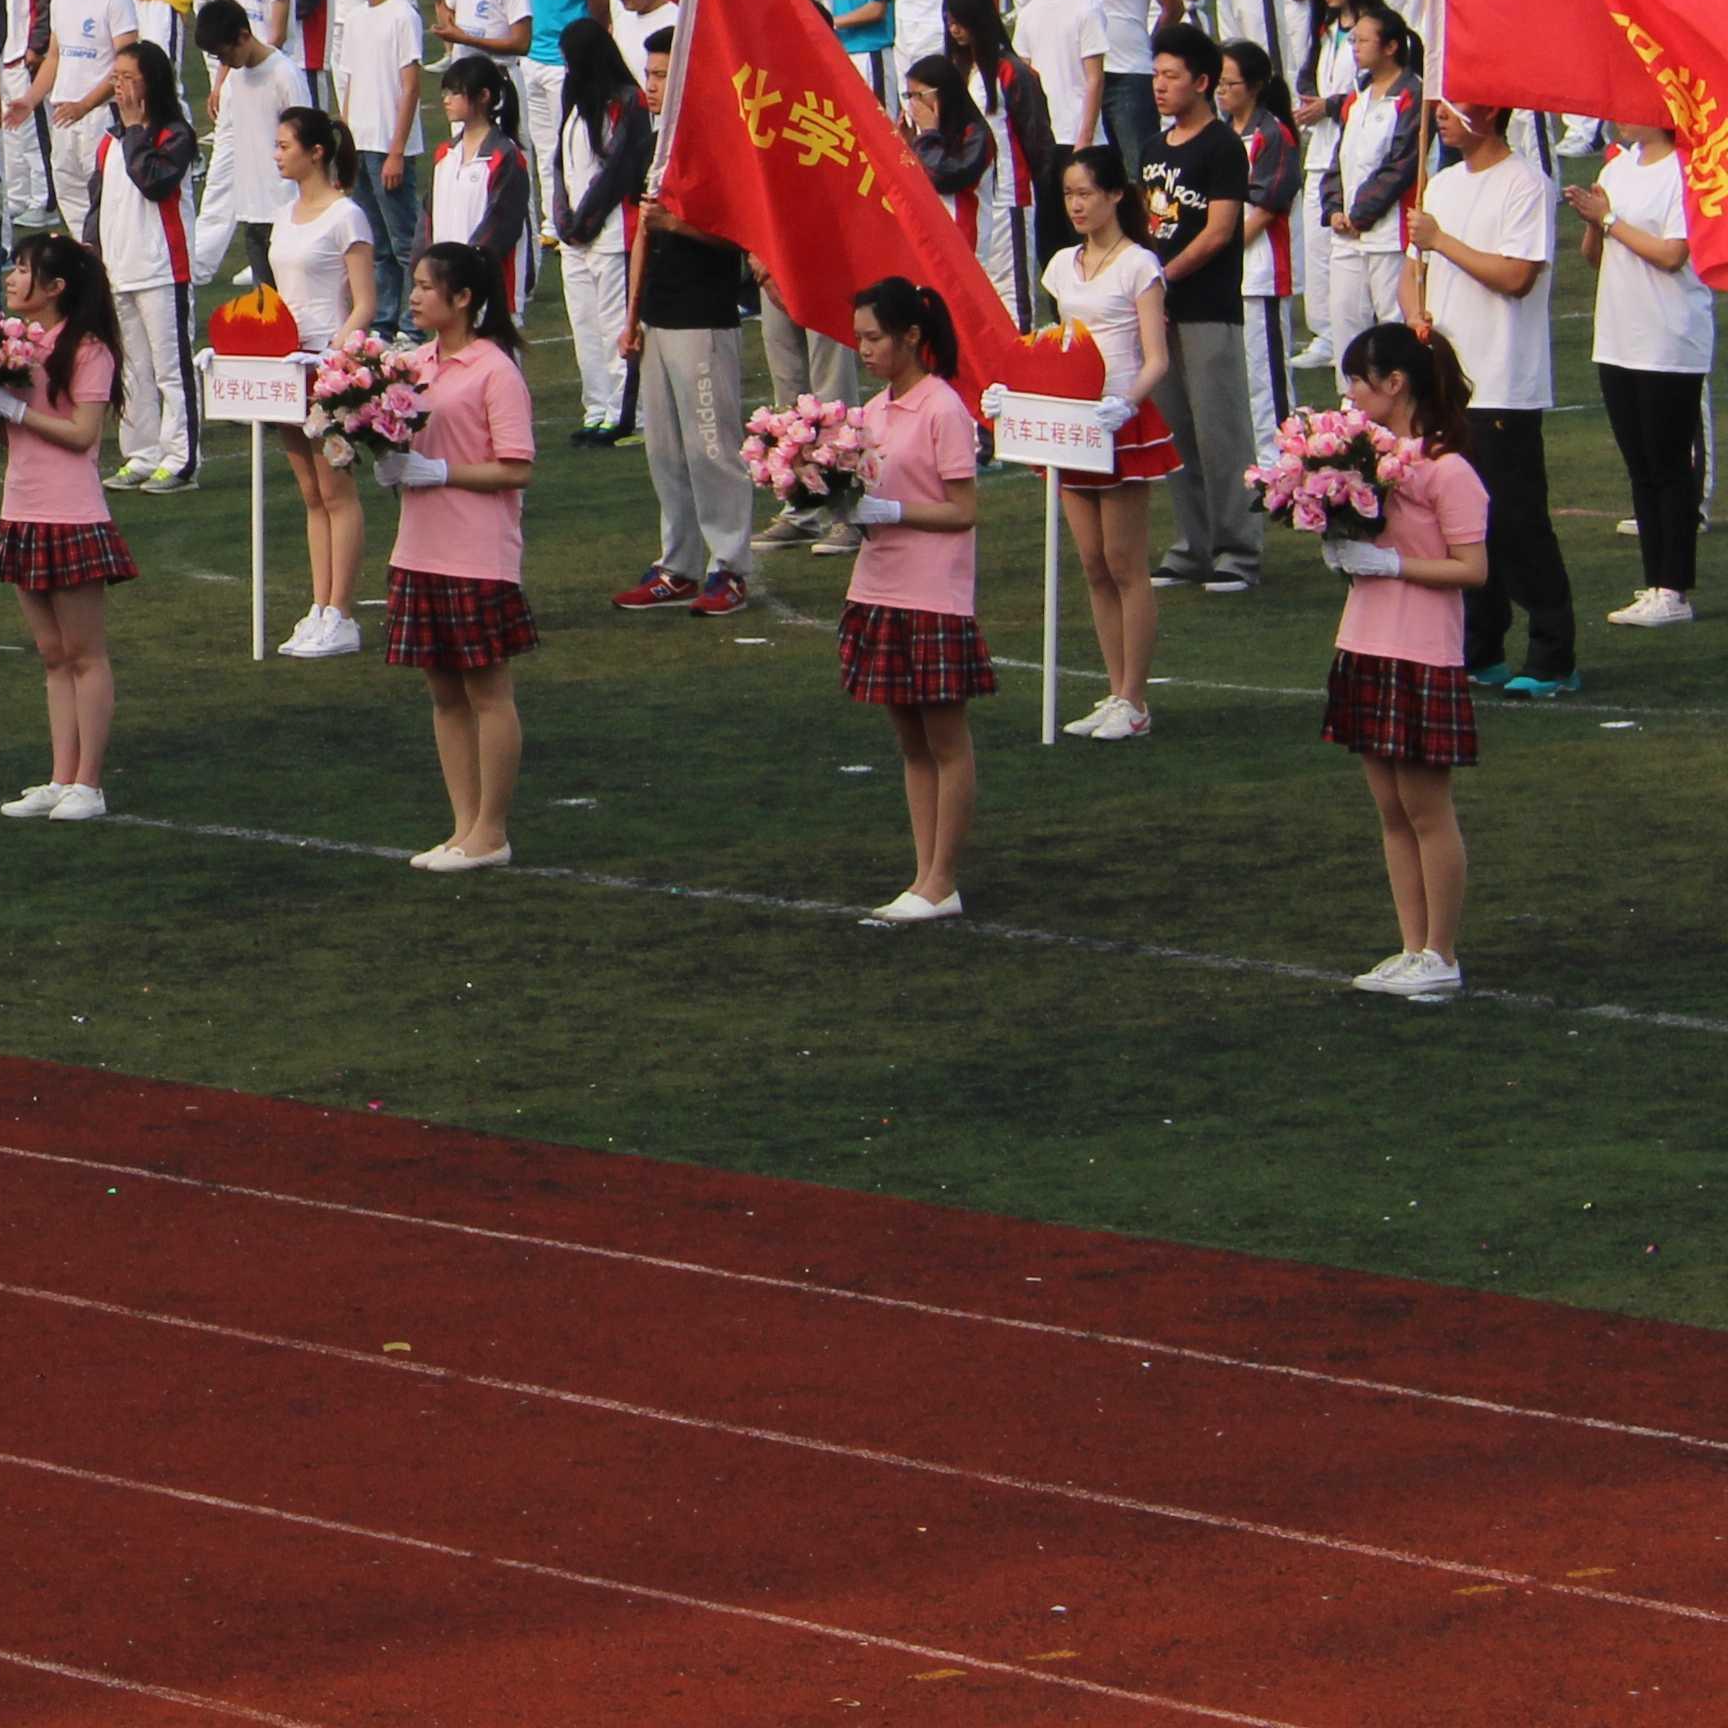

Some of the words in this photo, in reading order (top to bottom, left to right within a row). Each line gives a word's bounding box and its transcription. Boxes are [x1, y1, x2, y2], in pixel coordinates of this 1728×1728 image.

[1172, 185, 1208, 210] ROLL
[212, 378, 298, 402] 化学化工学院
[696, 375, 721, 460] adidas
[1002, 416, 1103, 449] 汽车工程学院
